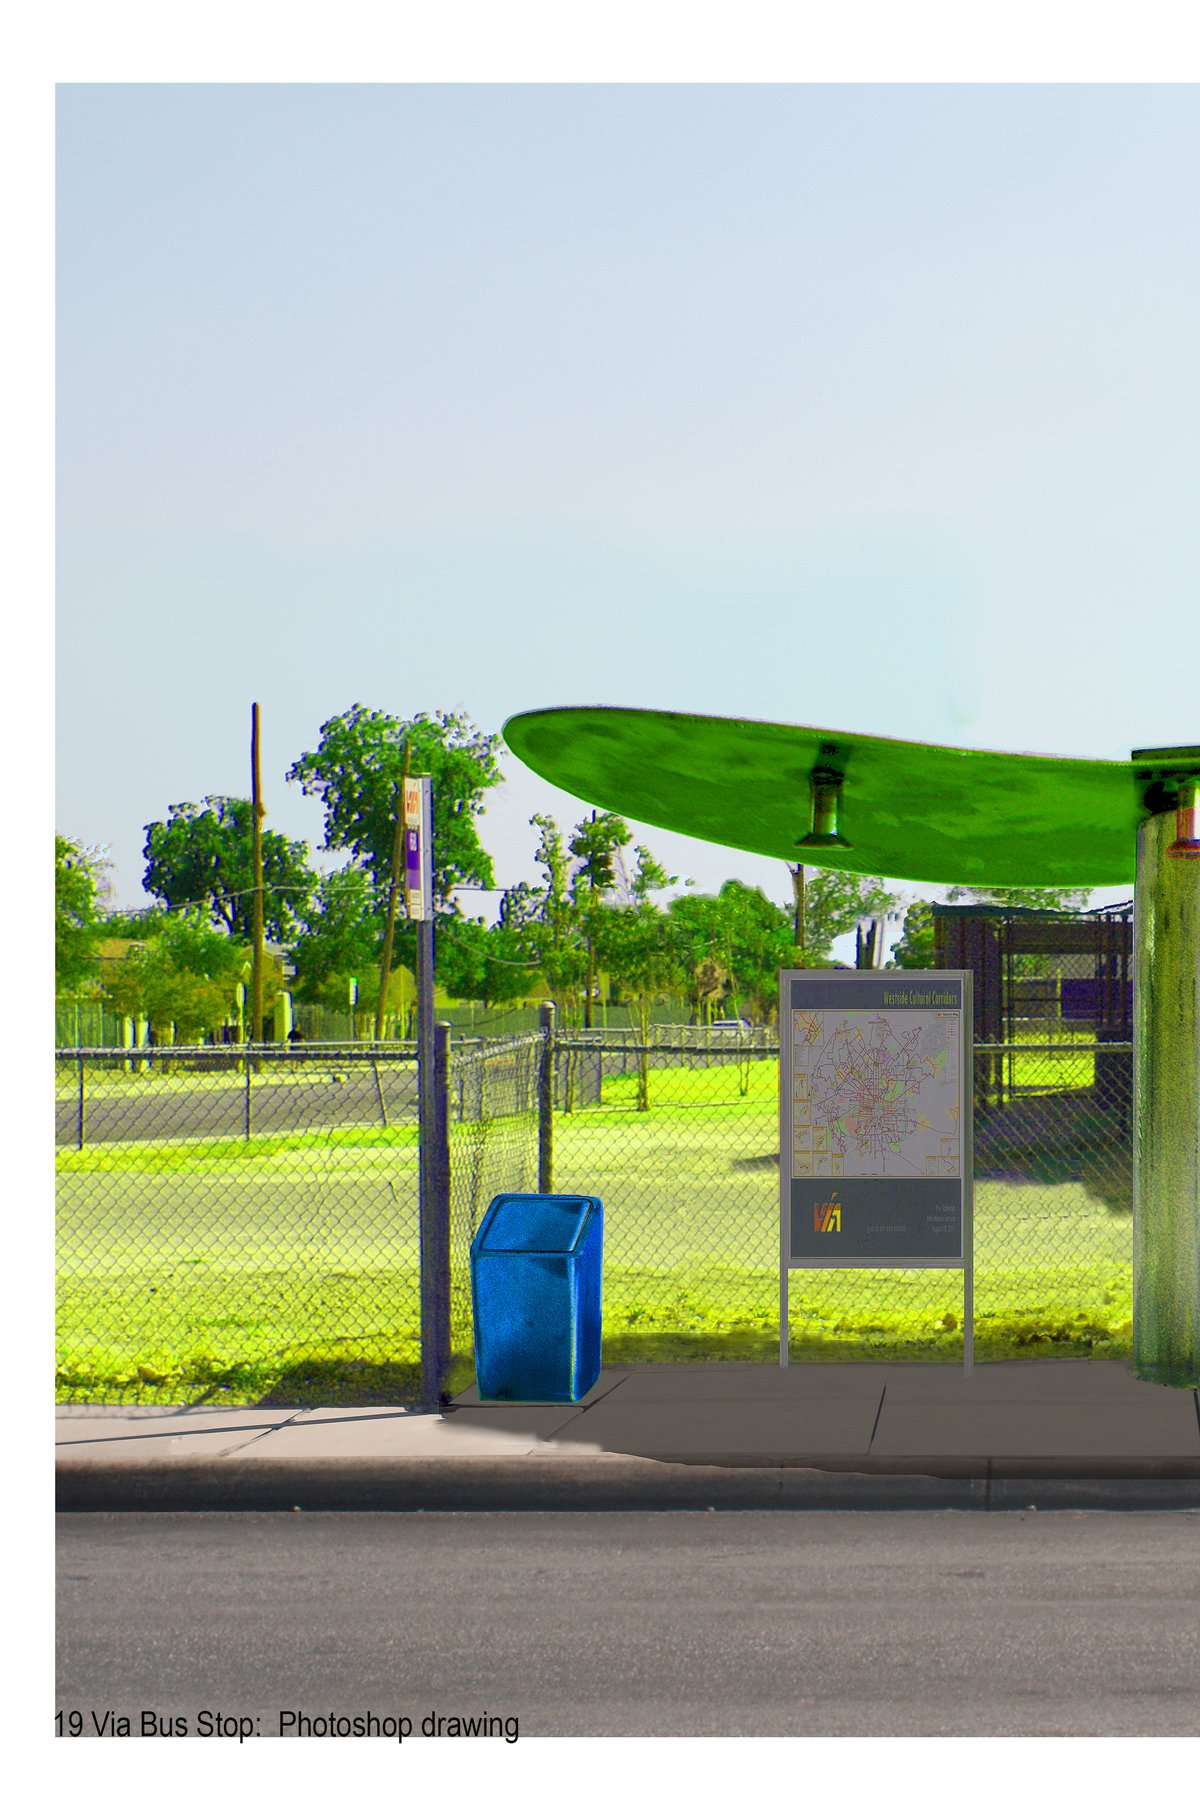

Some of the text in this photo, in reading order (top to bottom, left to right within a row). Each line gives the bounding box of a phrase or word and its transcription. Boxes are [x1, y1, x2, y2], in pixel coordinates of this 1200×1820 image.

[883, 990, 957, 1004] Westside Cultural Corridors
